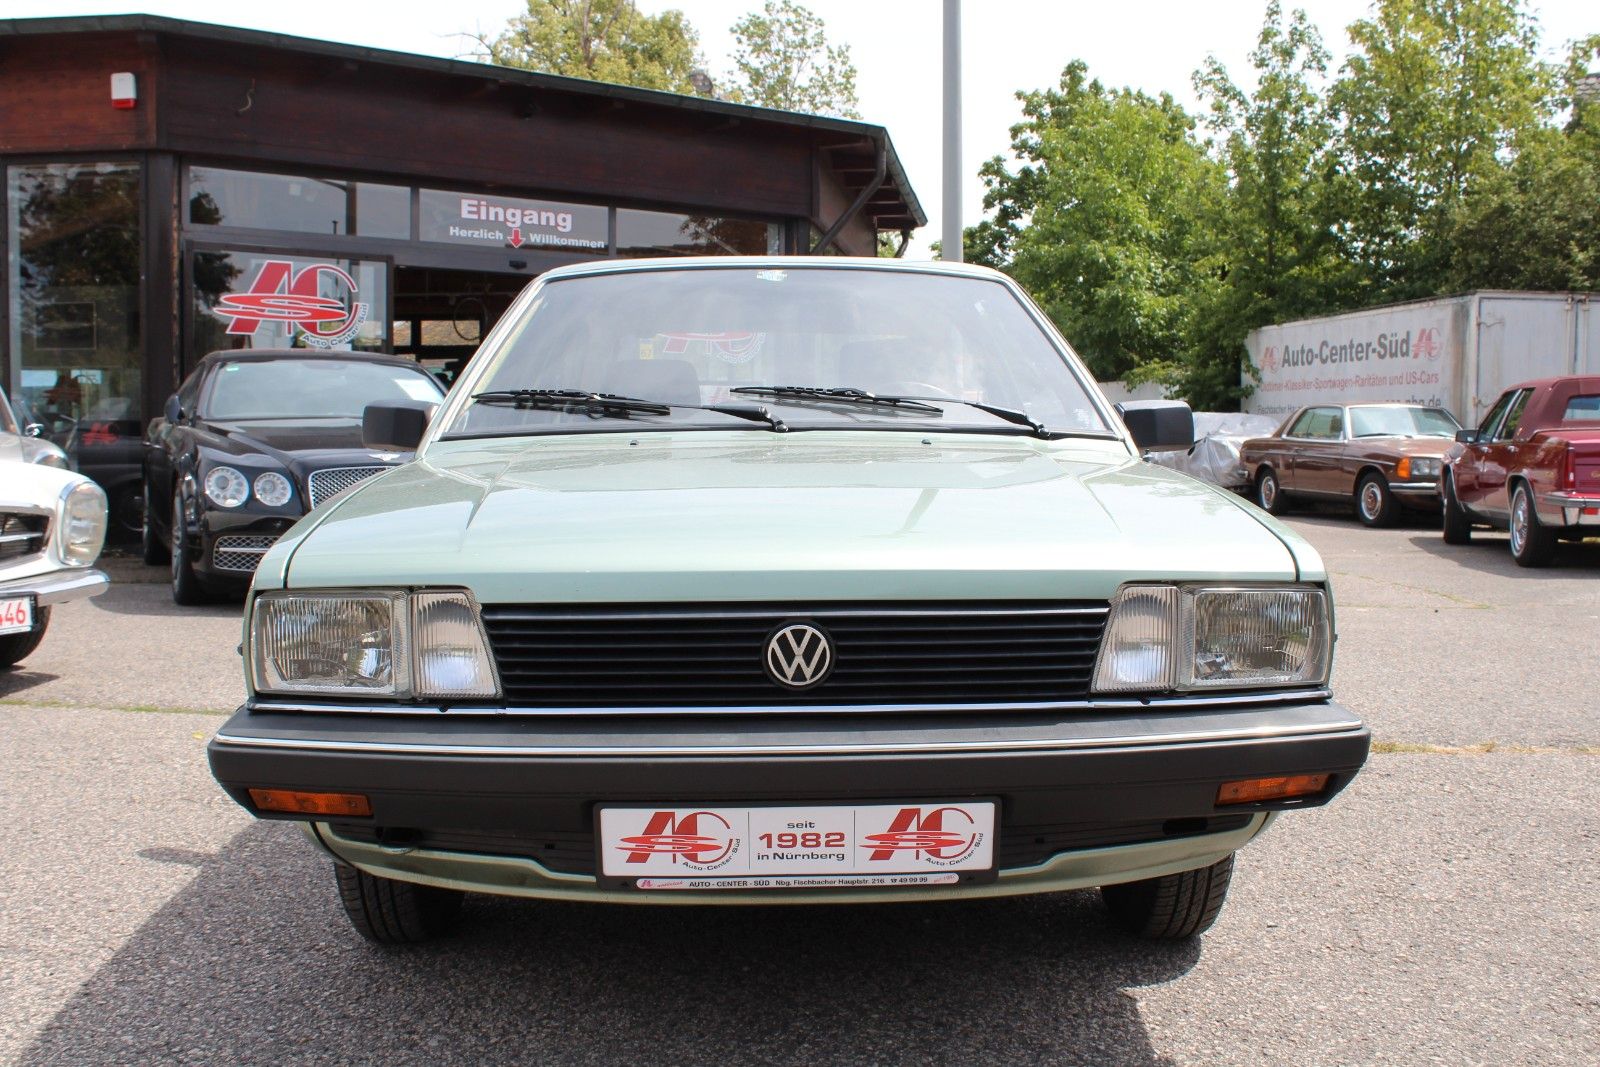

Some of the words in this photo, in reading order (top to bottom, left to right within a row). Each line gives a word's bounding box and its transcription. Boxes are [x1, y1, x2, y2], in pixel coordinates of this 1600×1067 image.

[460, 198, 573, 233] Eingang
[449, 225, 503, 241] Herzlich
[529, 232, 605, 249] Willkommen
[1281, 330, 1410, 368] Auto-Center-Süd
[1389, 373, 1404, 387] und
[1406, 371, 1440, 386] US-Cars
[0, 602, 26, 625] 46
[768, 625, 831, 686] VW
[787, 820, 816, 829] seit
[758, 832, 845, 849] 1982
[757, 852, 769, 860] in
[773, 852, 845, 862] Nürnberg
[775, 879, 791, 887] Nbg.
[793, 878, 837, 886] Fischbacher
